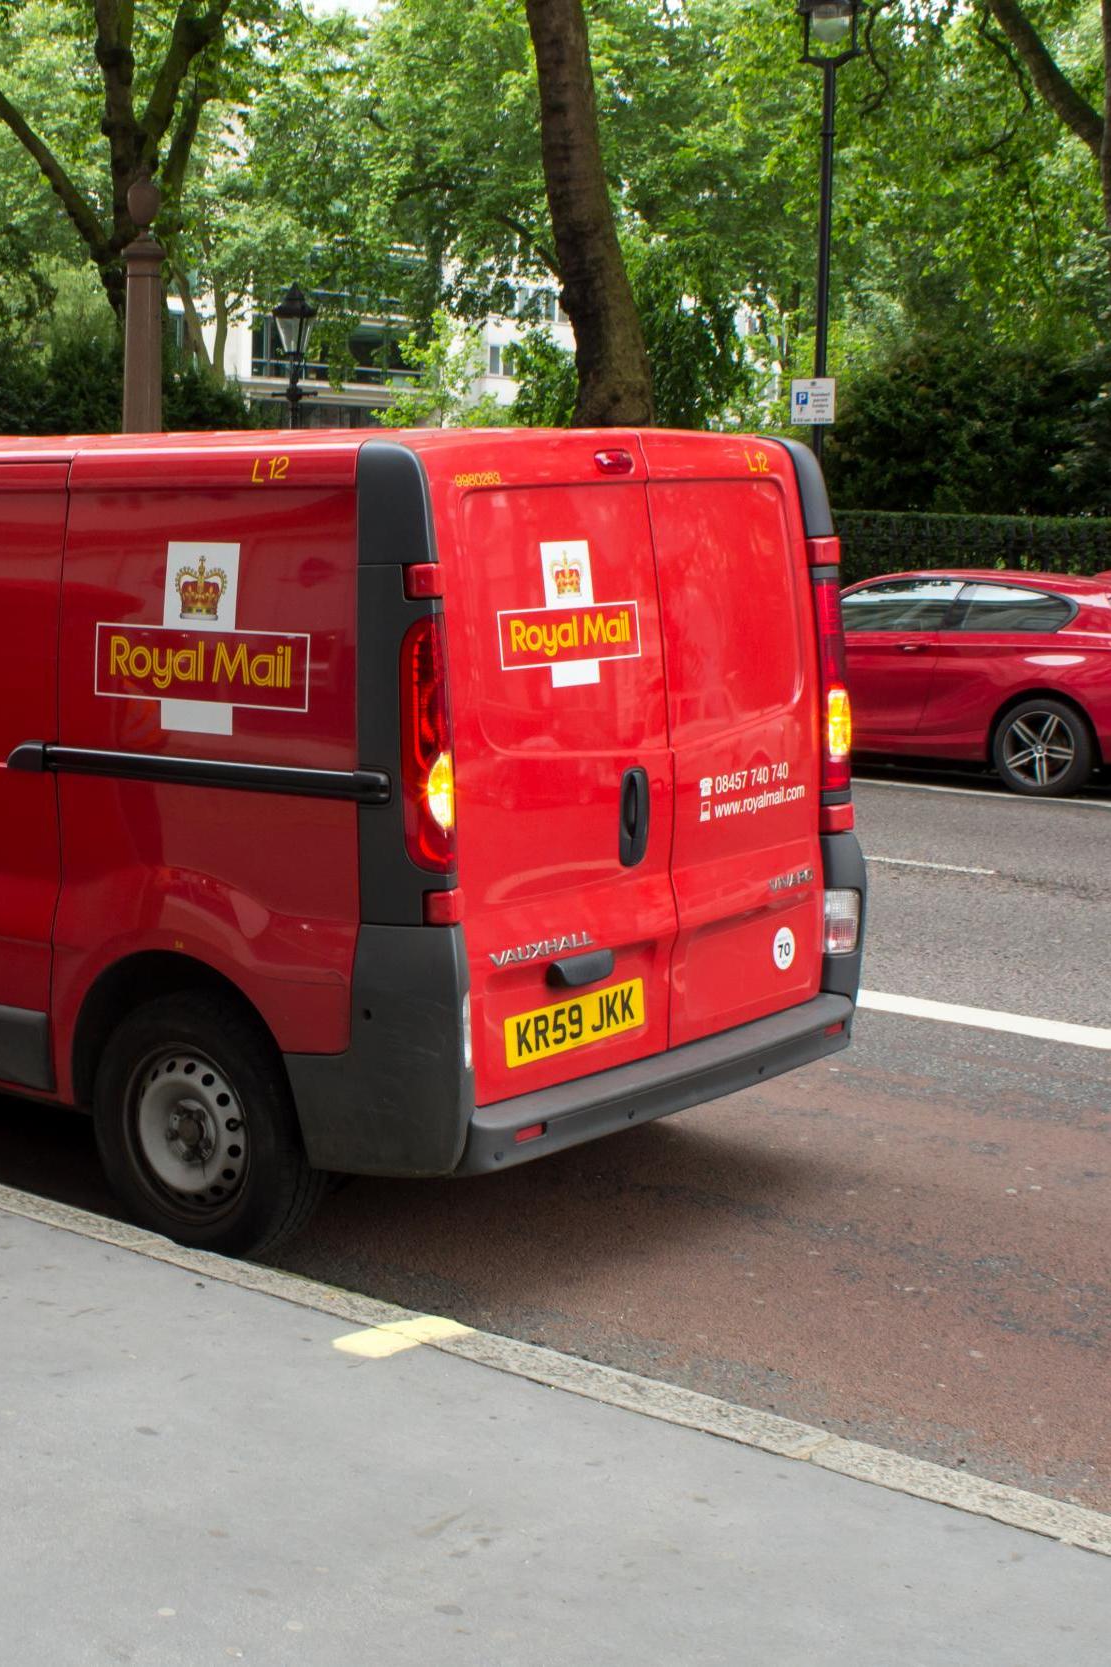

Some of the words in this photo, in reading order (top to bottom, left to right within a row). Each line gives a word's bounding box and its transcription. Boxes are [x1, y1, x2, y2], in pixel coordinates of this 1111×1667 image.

[510, 615, 579, 657] Royal
[583, 611, 630, 646] Mail
[110, 635, 205, 689] Royal
[212, 642, 292, 688] Mail
[715, 771, 748, 794] 08457
[751, 766, 769, 786] 740
[771, 762, 789, 781] 740
[714, 785, 805, 818] www.royalmail.com
[489, 931, 593, 966] VAUXHALL
[777, 942, 790, 959] 70
[516, 1004, 583, 1057] KR59
[591, 986, 635, 1033] JKK
